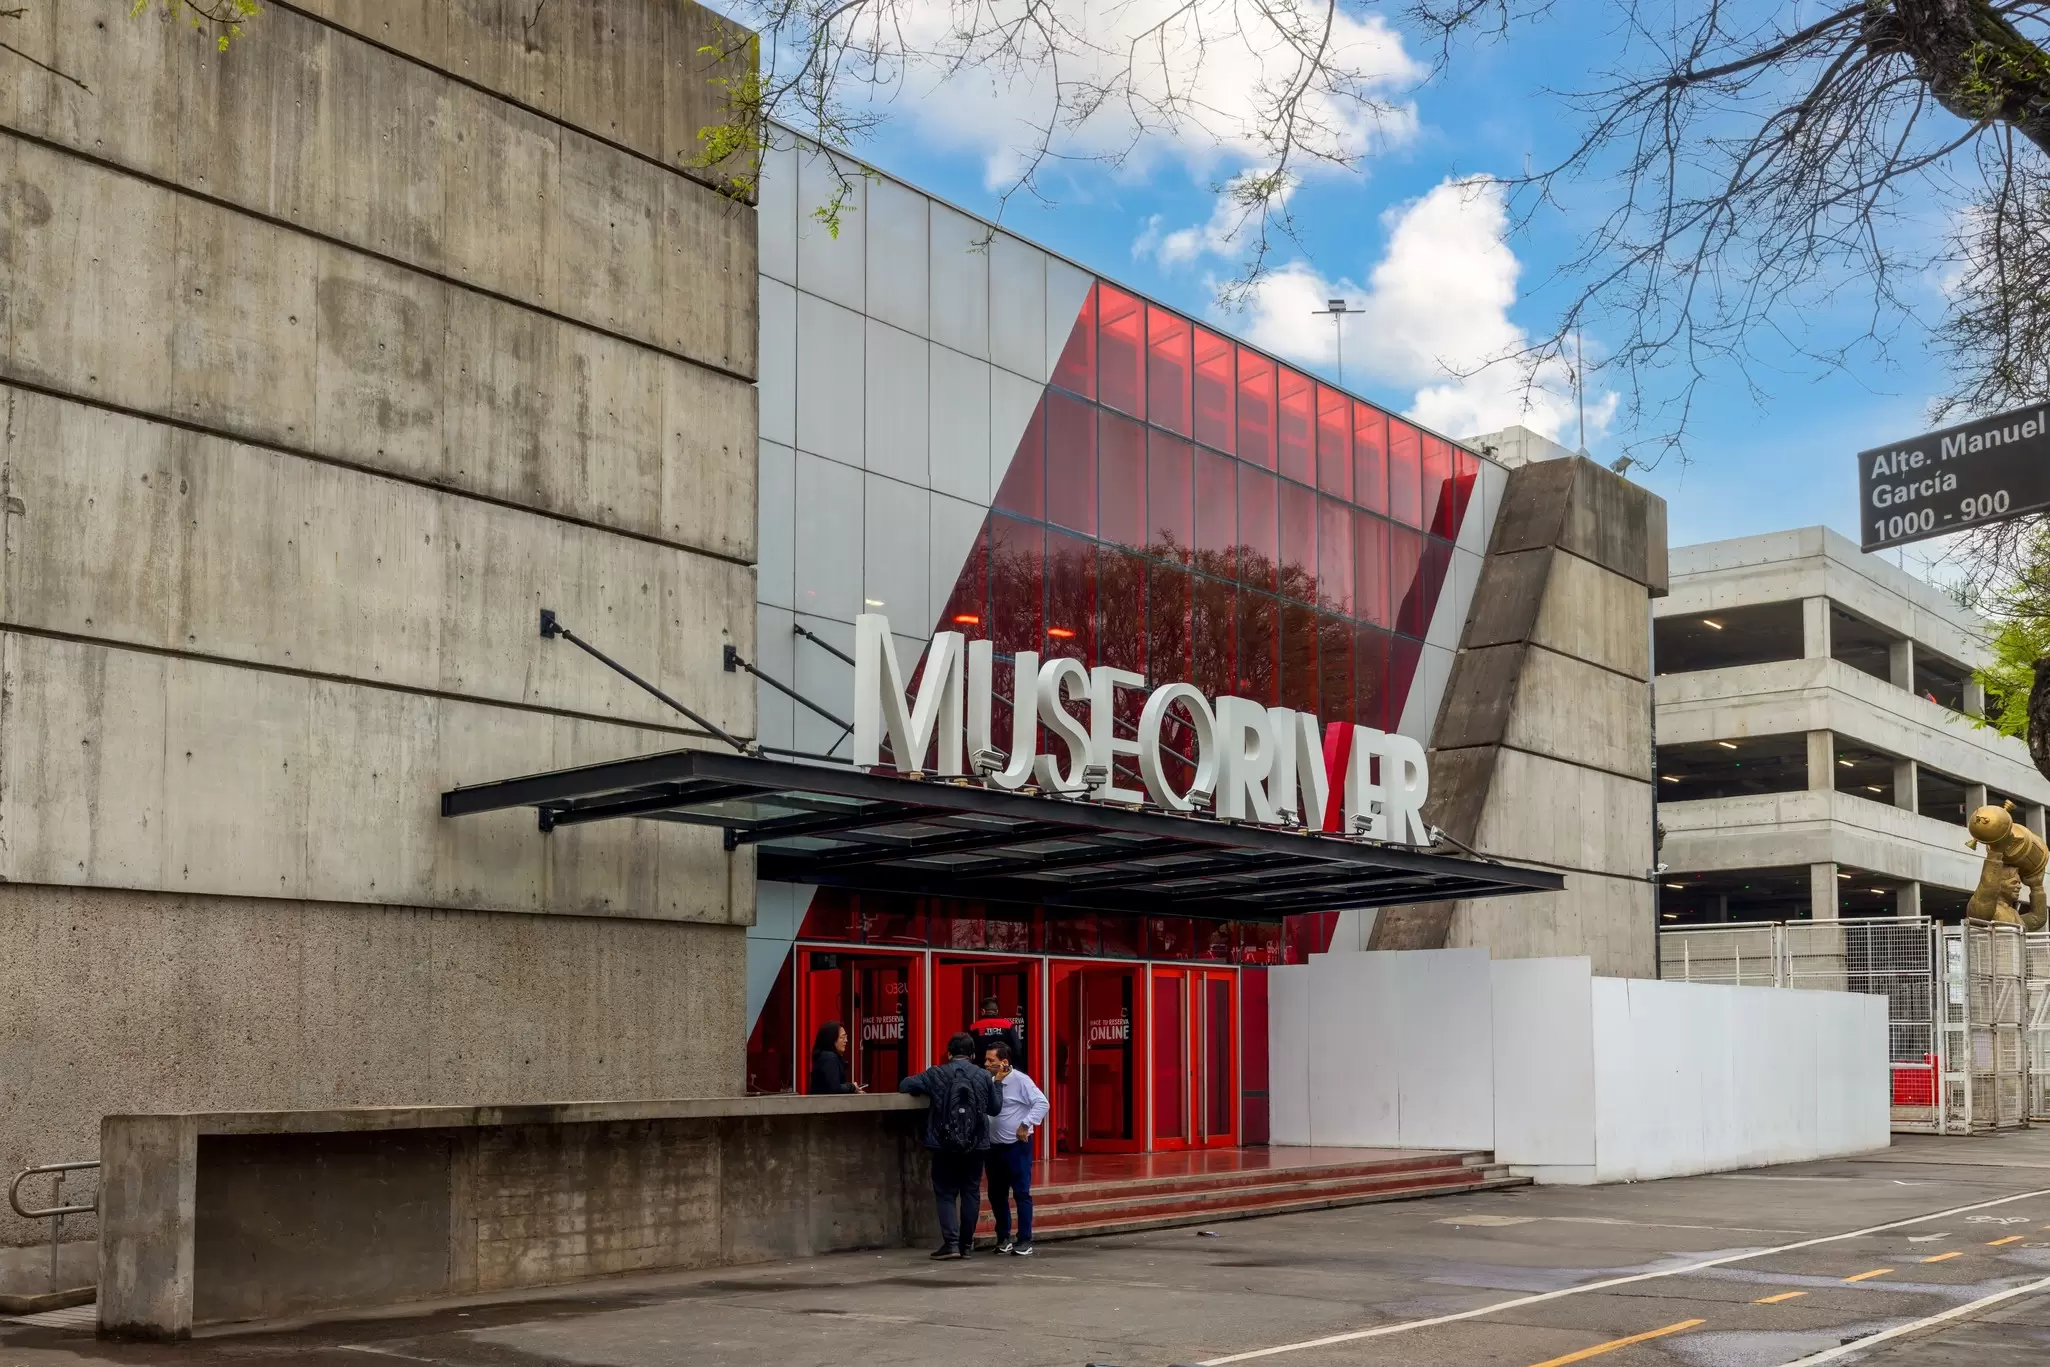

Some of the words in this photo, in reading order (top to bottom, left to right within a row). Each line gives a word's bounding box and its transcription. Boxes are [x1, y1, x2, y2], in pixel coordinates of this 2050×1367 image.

[1871, 450, 1931, 479] Alte.
[1941, 411, 2046, 461] Manuel
[1872, 470, 1957, 508] García
[1874, 508, 1935, 541] 1000
[1960, 490, 2010, 521] 900
[883, 1015, 904, 1023] RESERVA
[1109, 1018, 1129, 1026] RESERVA
[863, 1023, 905, 1040] ONLINE
[1090, 1025, 1130, 1040] ONLINE
